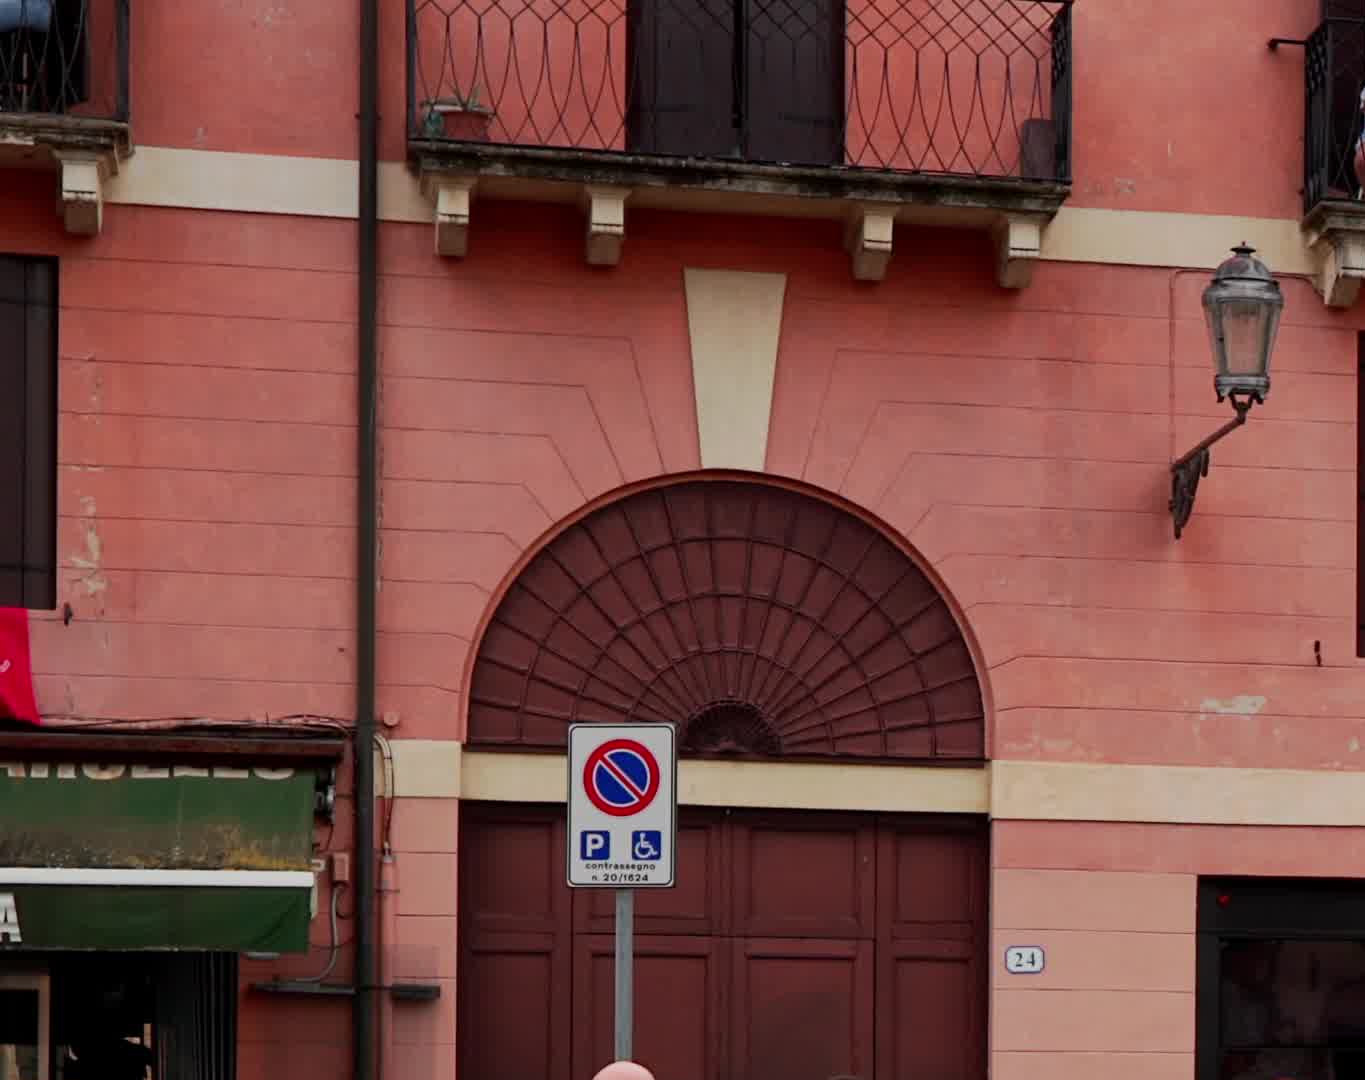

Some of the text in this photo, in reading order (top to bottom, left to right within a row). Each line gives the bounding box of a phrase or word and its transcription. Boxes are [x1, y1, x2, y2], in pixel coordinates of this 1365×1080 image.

[586, 833, 604, 857] P
[585, 862, 656, 871] contrassegno
[1016, 952, 1035, 967] 24
